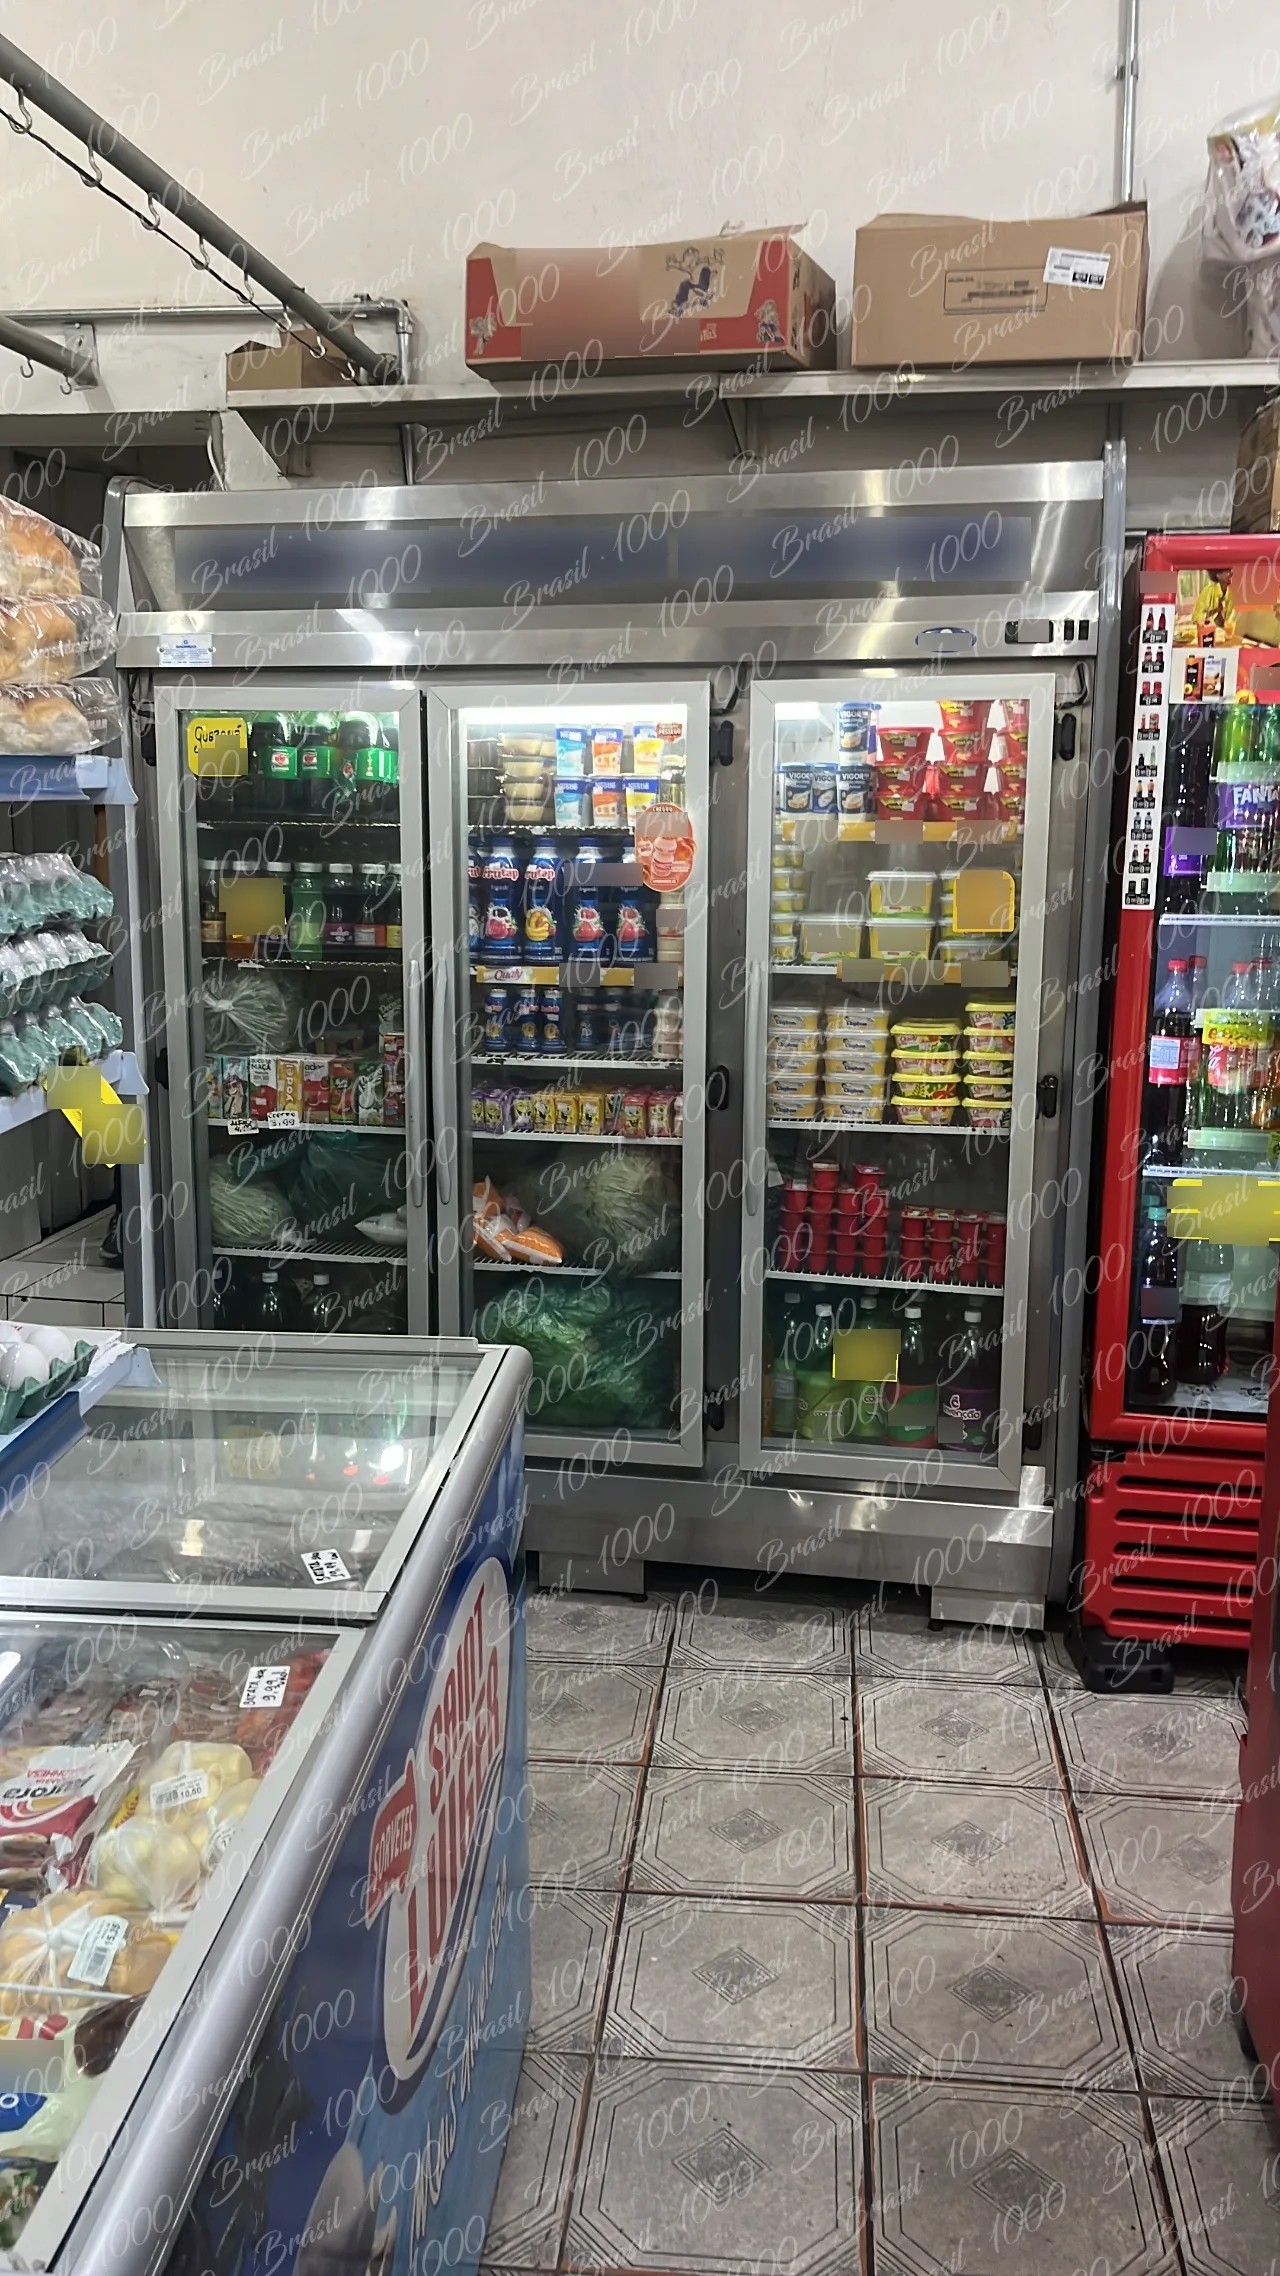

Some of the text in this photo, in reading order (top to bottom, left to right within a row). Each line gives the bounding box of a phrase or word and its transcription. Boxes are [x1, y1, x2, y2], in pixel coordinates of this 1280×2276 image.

[840, 710, 862, 718] VIGOR
[789, 771, 811, 780] VIGOR
[842, 772, 865, 780] VIGOR
[428, 1582, 485, 1816] SAINT
[373, 1803, 414, 1892] SORVETES
